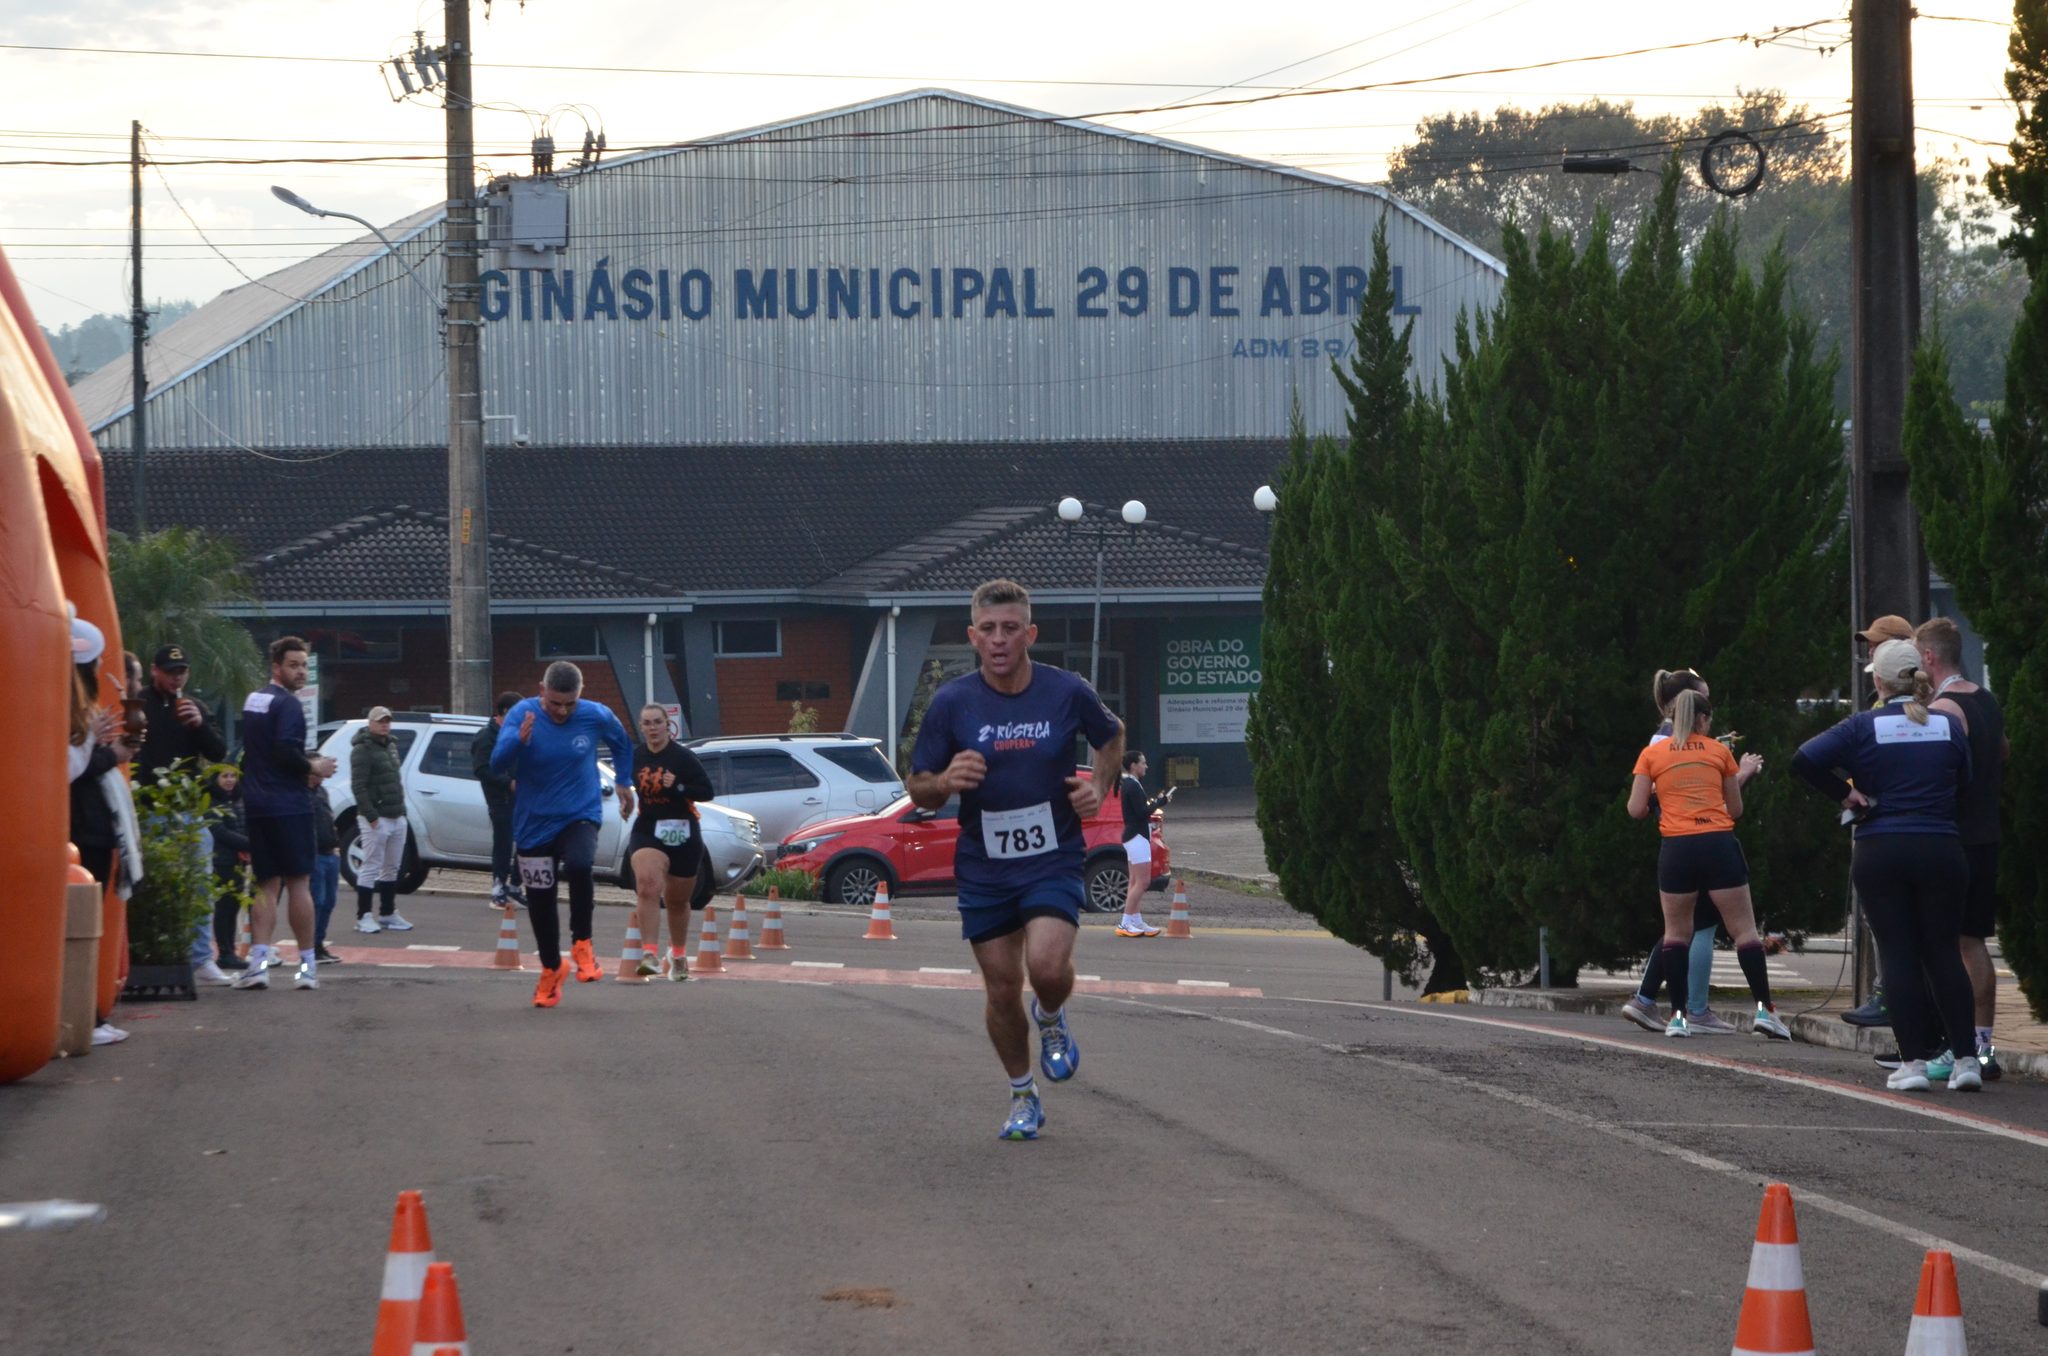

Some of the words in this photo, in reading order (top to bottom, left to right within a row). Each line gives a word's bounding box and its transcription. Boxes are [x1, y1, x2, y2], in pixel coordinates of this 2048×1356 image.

[479, 256, 712, 321] GINÁSIO
[735, 267, 1055, 320] MUNICIPAL
[1077, 266, 1149, 317] 29
[1169, 266, 1240, 317] DE
[1260, 265, 1422, 317] ABRL
[1167, 640, 1215, 653] OBRA
[1219, 639, 1243, 652] DO
[1167, 655, 1250, 669] GOVERNO
[1167, 671, 1192, 685] DO
[1197, 670, 1262, 685] ESTADO
[660, 829, 688, 844] 206
[994, 824, 1046, 854] 783
[522, 868, 553, 886] 943
